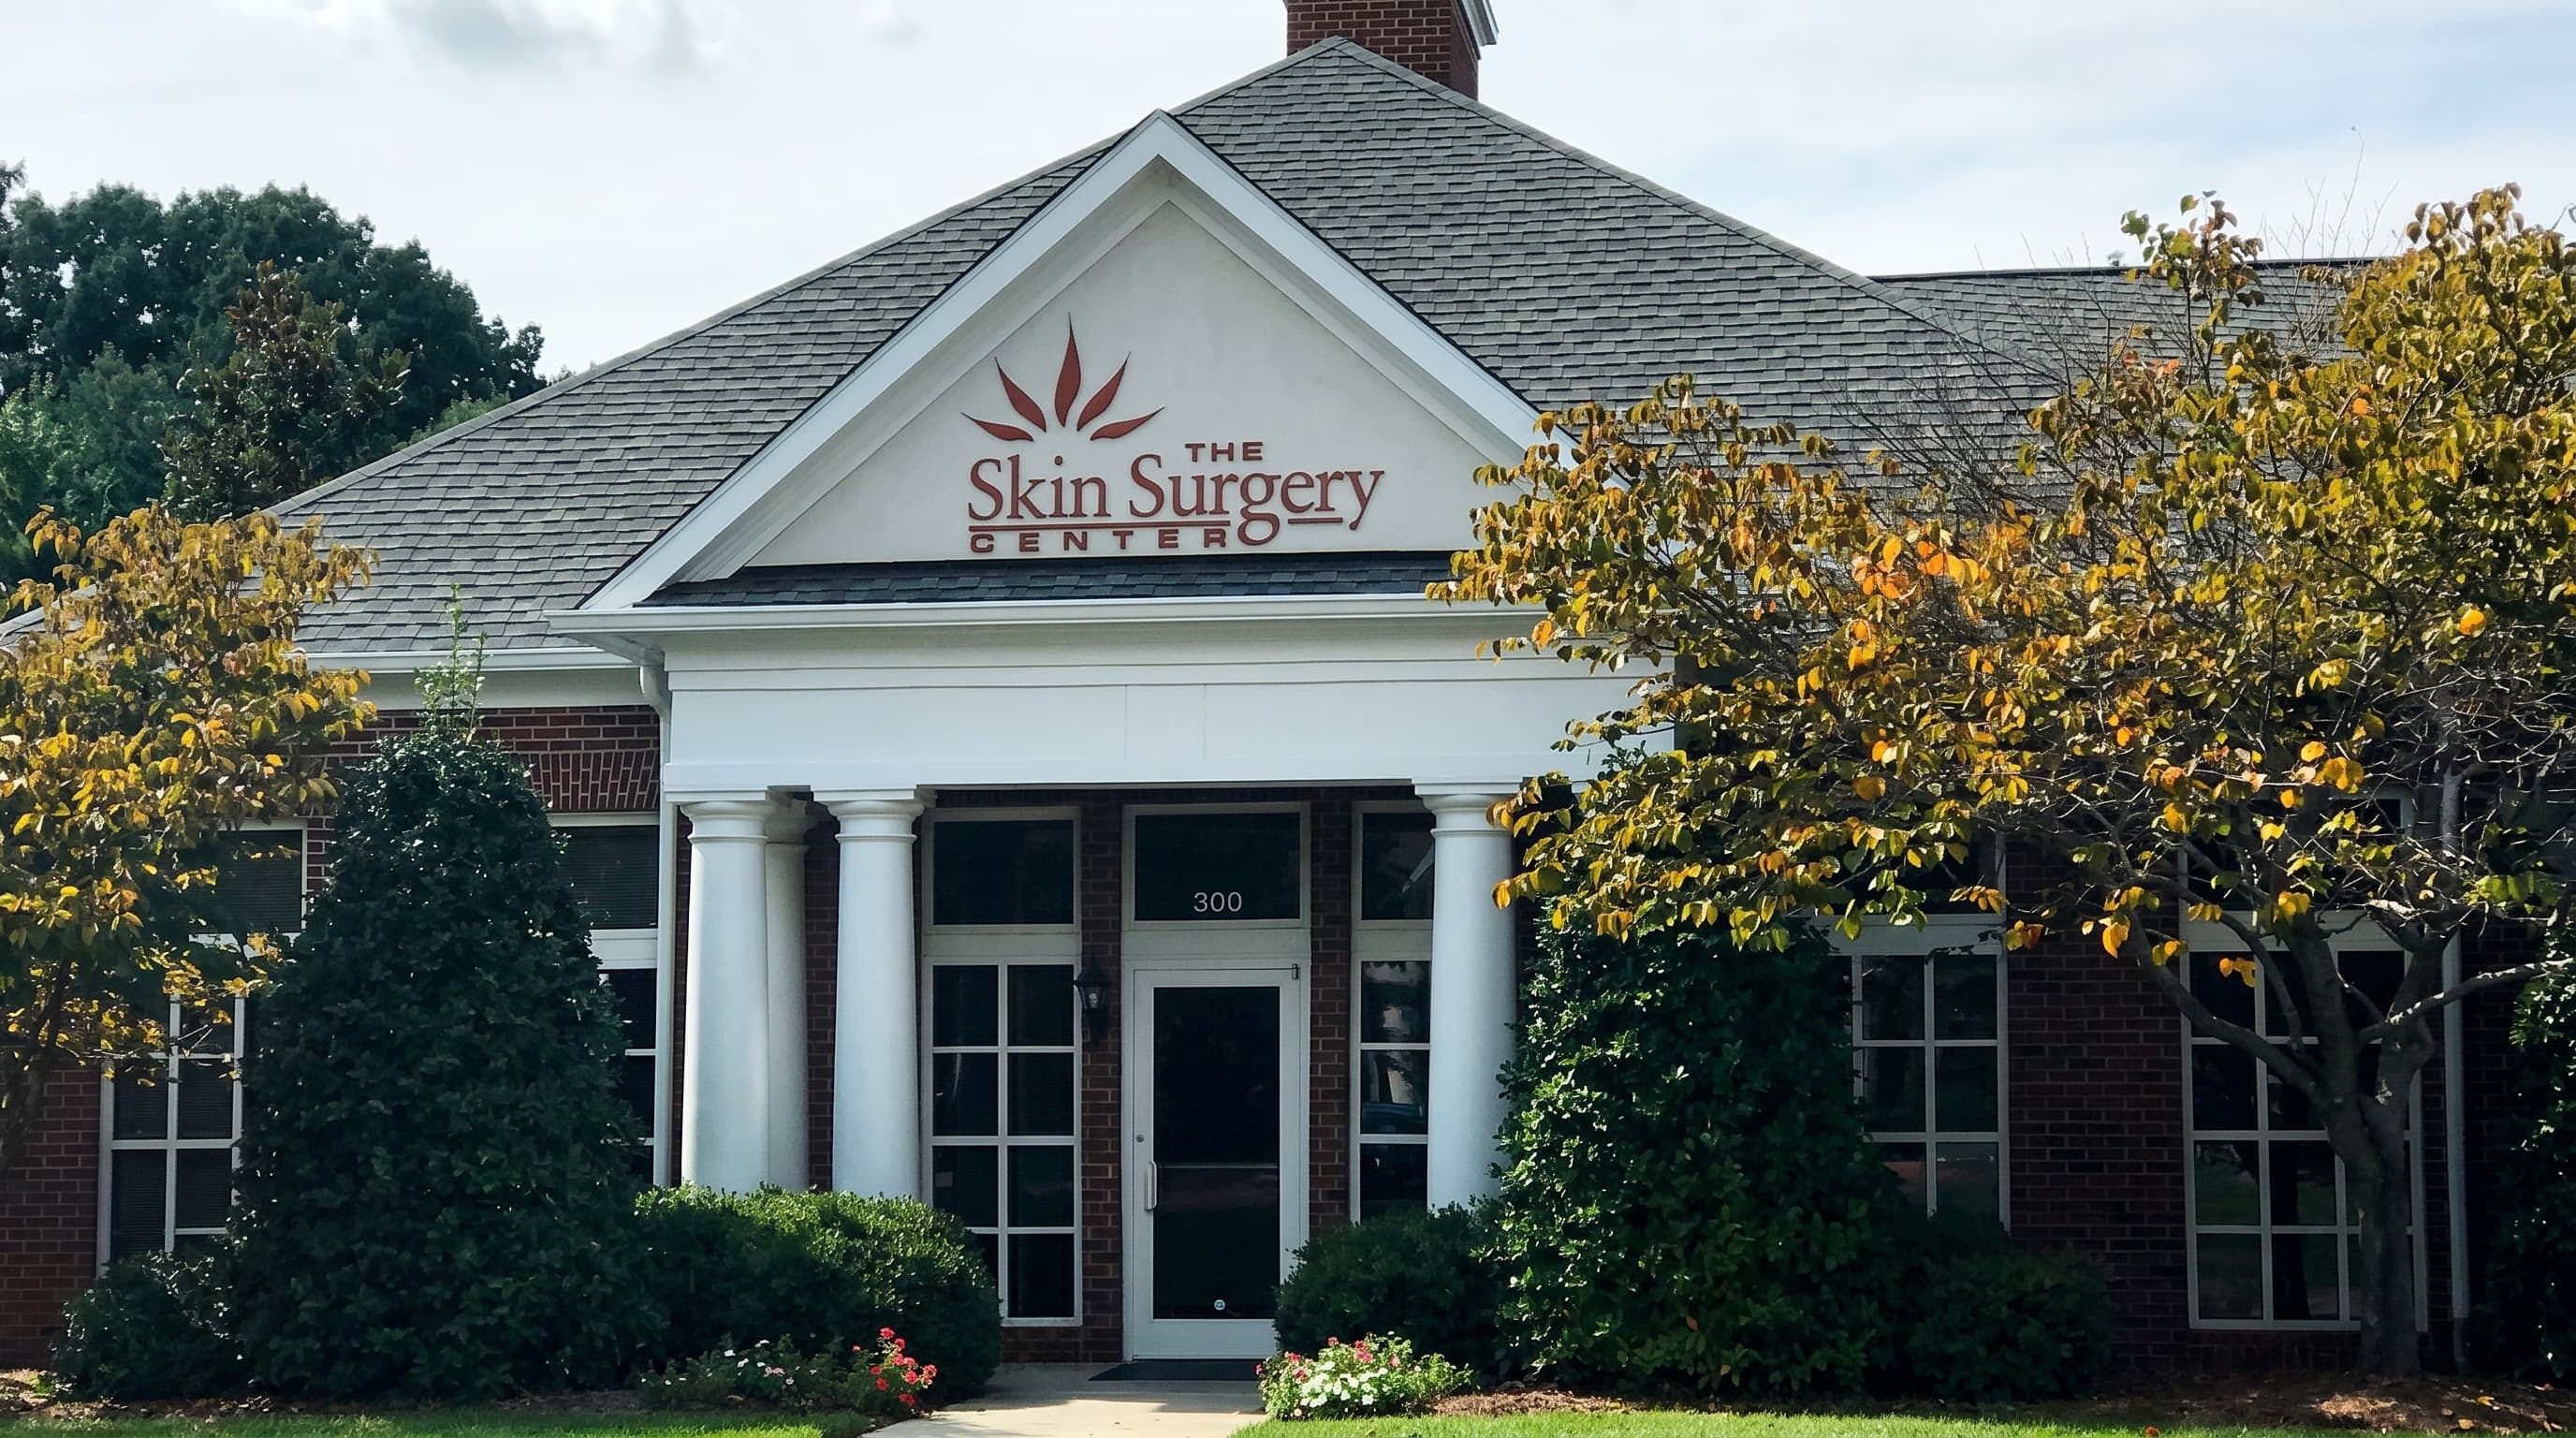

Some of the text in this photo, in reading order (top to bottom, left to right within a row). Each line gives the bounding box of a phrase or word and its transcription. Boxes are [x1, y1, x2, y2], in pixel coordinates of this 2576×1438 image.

[1185, 442, 1263, 462] THE
[968, 454, 1385, 546] Skin Surgery
[970, 528, 1227, 552] CENTER
[1193, 892, 1243, 912] 300
